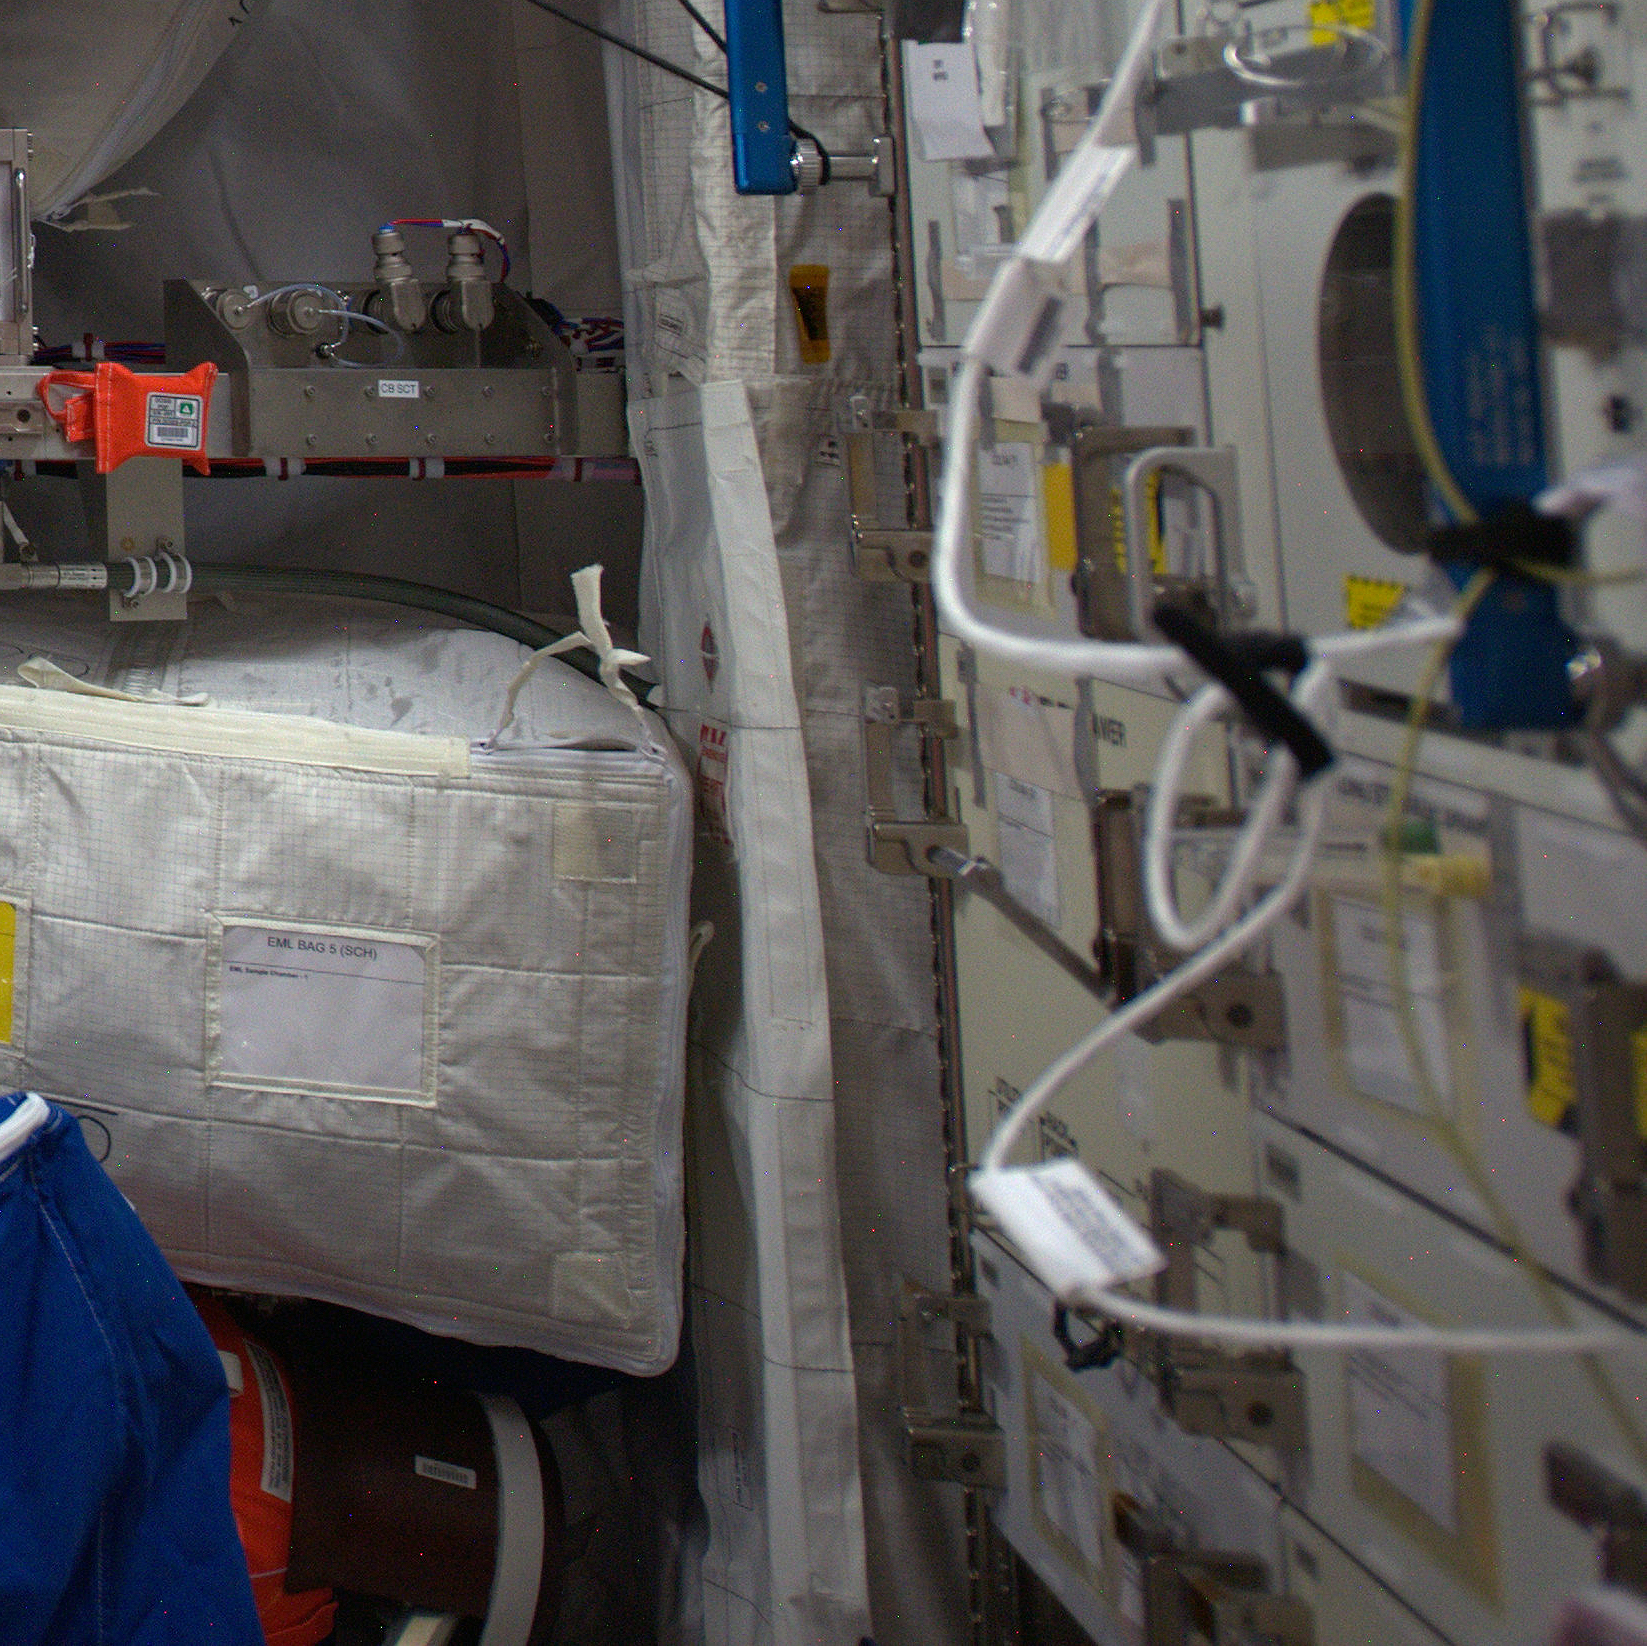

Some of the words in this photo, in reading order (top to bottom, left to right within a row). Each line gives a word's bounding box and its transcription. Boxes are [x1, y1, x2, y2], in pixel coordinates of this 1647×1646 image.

[397, 384, 416, 394] SCT
[267, 936, 293, 951] EML
[298, 939, 325, 954] BAG
[329, 943, 337, 955] 5
[340, 944, 377, 961] (SCH)
